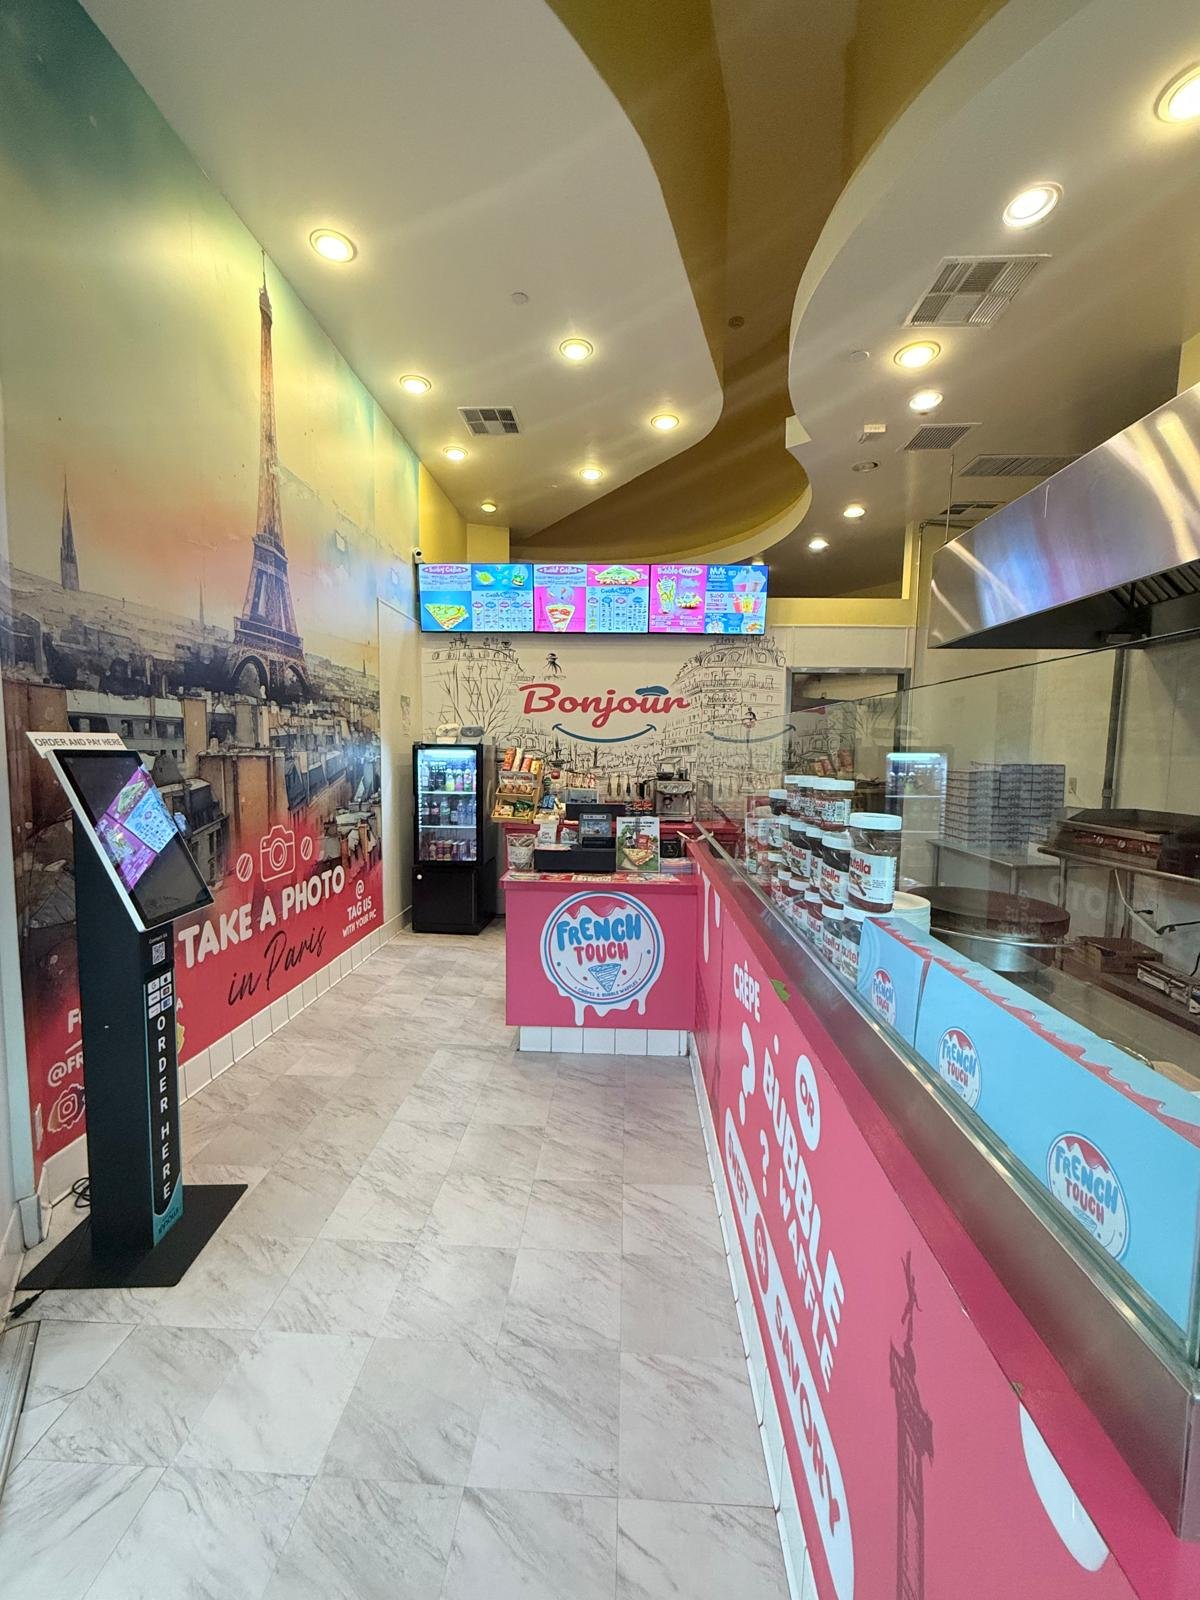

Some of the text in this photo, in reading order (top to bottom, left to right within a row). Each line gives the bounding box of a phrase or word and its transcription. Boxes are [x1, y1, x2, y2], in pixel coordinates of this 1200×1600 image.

[519, 683, 690, 728] Bonjour
[34, 738, 123, 747] ORDER AND PAY HERE
[178, 865, 345, 969] TAKE A PHOTO
[342, 922, 356, 938] WITH
[346, 896, 372, 921] TAG US
[556, 913, 642, 951] FRENCH
[228, 925, 328, 1006] in Paris
[573, 941, 629, 966] TOUCH
[733, 959, 760, 1024] CRÊPE
[48, 1051, 84, 1087] @FR
[156, 1016, 169, 1114] ORDER
[942, 1038, 978, 1078] FRENCH
[946, 1060, 969, 1088] TOUCH
[800, 1074, 815, 1128] OR
[160, 1122, 172, 1200] HERE
[1055, 1145, 1119, 1215] FRENCH
[762, 1047, 845, 1348] BUBBLE
[1064, 1176, 1106, 1226] TOUCH
[779, 1167, 834, 1393] WAFFLE
[774, 1294, 841, 1538] SAVORY
